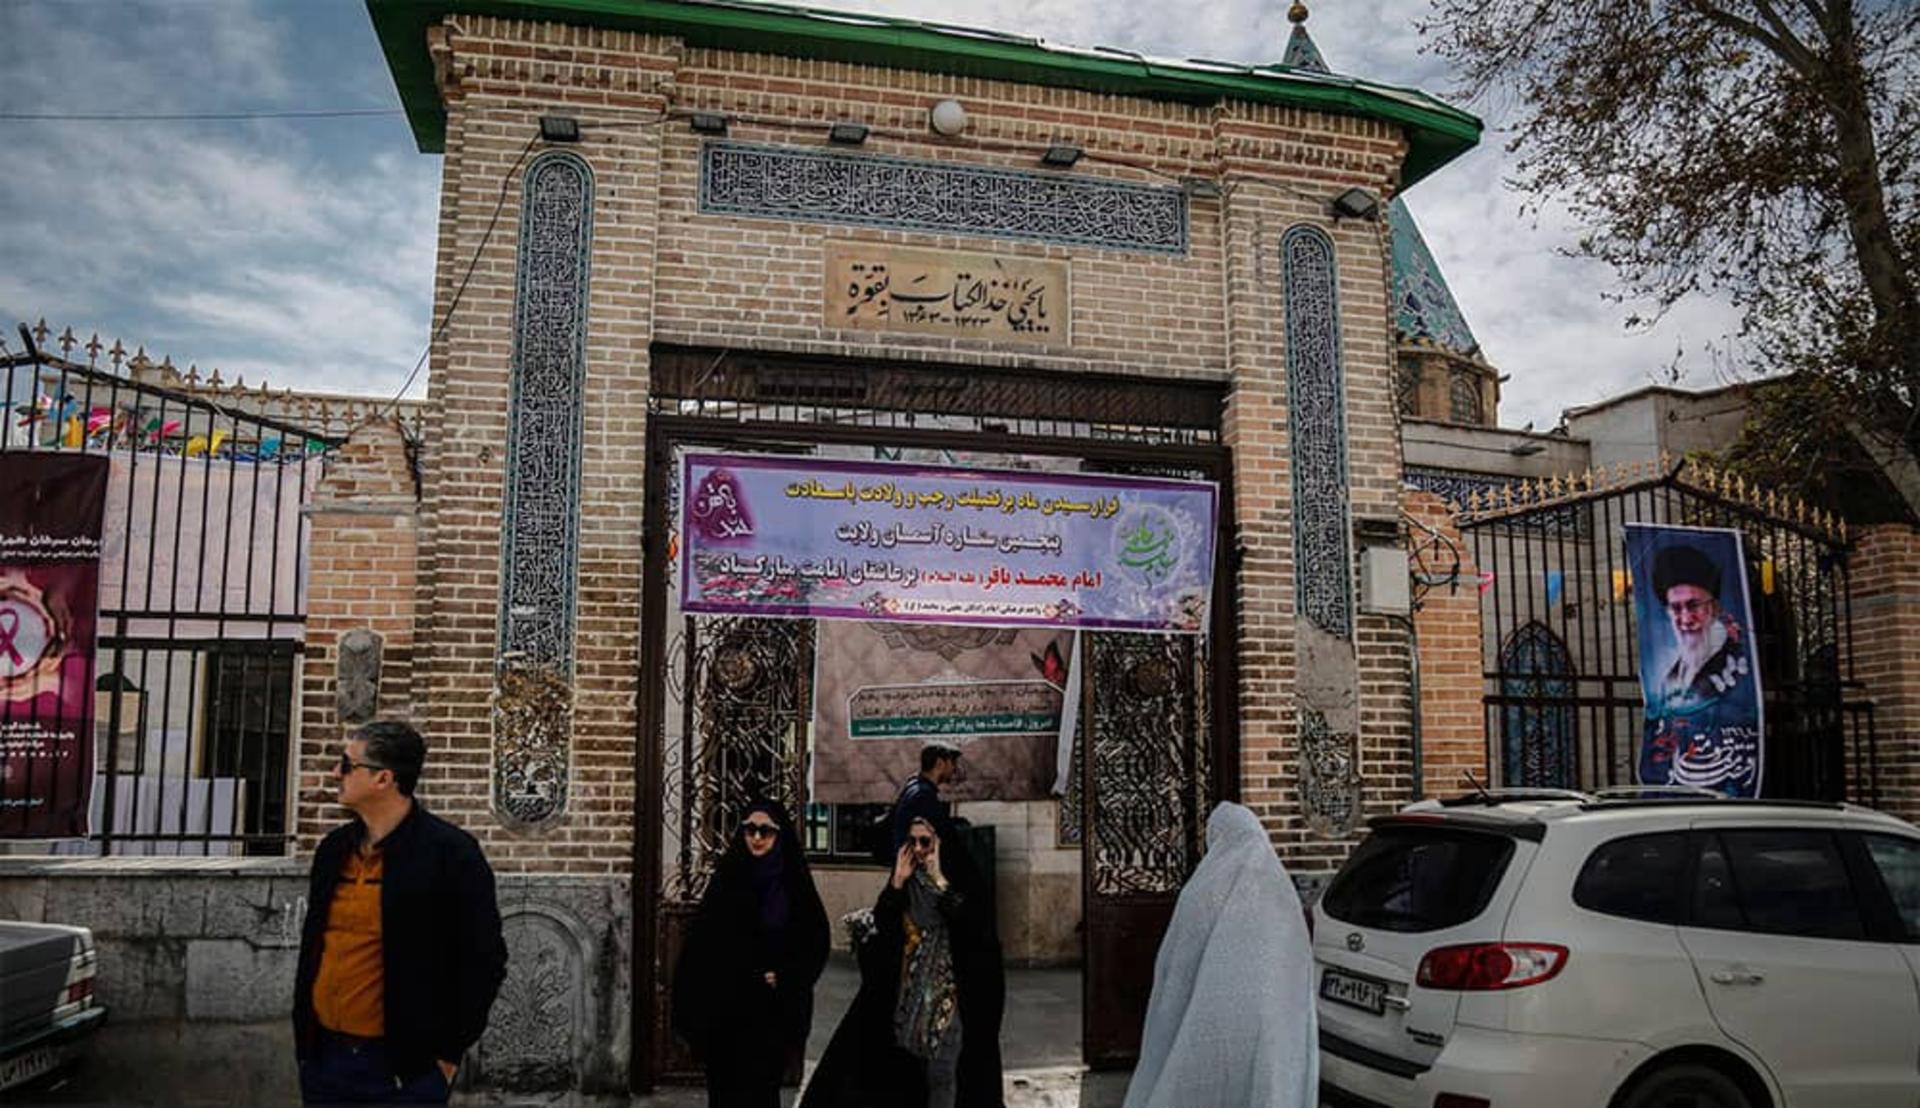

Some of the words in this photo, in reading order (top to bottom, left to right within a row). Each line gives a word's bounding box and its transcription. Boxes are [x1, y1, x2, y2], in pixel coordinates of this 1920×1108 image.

[859, 481, 903, 508] ولادت
[918, 488, 954, 512] رجب
[1017, 490, 1040, 511] ماه
[1041, 494, 1120, 519] فرارسیدن
[834, 521, 880, 547] ولایت
[881, 522, 944, 548] آسمان
[944, 525, 996, 551] ستاره
[998, 532, 1063, 557] پنجمین
[800, 558, 848, 579] امامت
[984, 564, 1011, 590] باقر
[1015, 571, 1068, 587] محمد
[1072, 569, 1102, 591] امام
